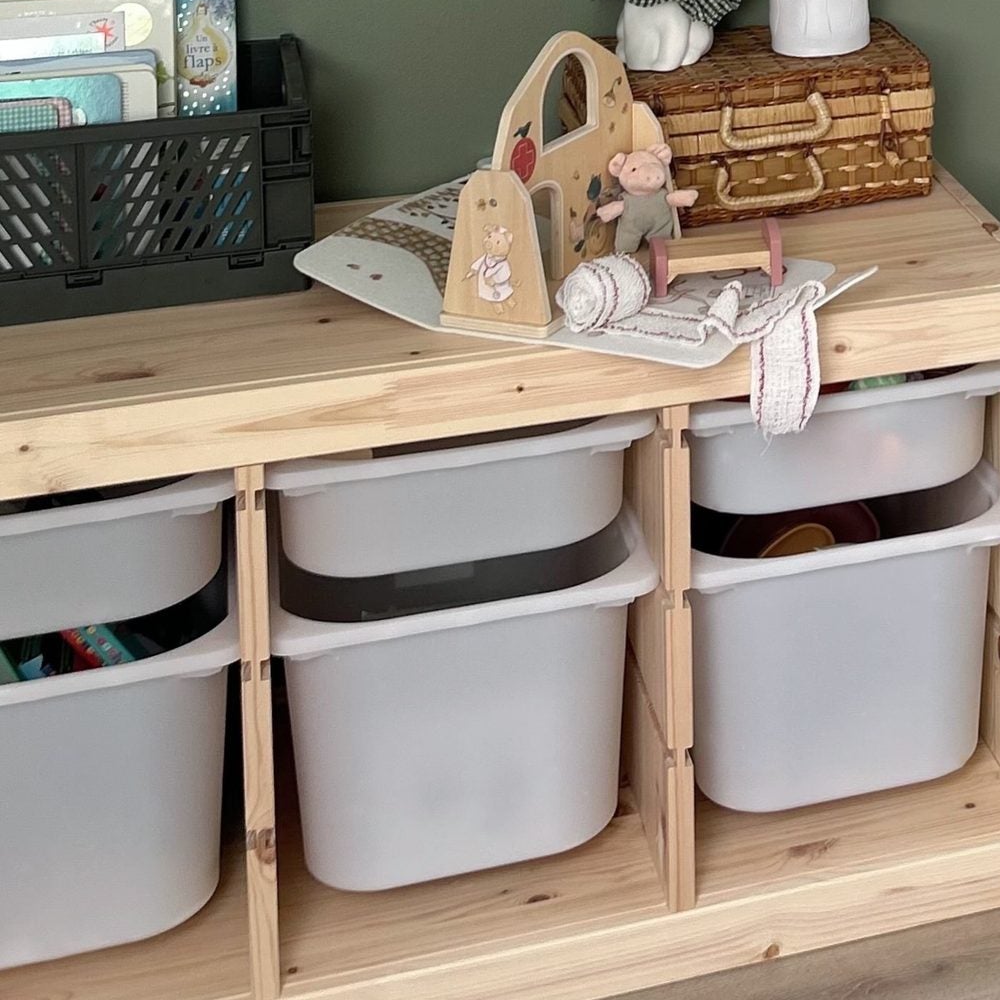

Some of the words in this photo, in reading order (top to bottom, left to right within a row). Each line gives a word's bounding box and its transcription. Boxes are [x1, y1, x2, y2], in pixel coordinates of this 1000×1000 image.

[196, 34, 208, 43] Un
[186, 43, 210, 54] livre
[184, 54, 222, 72] flaps
